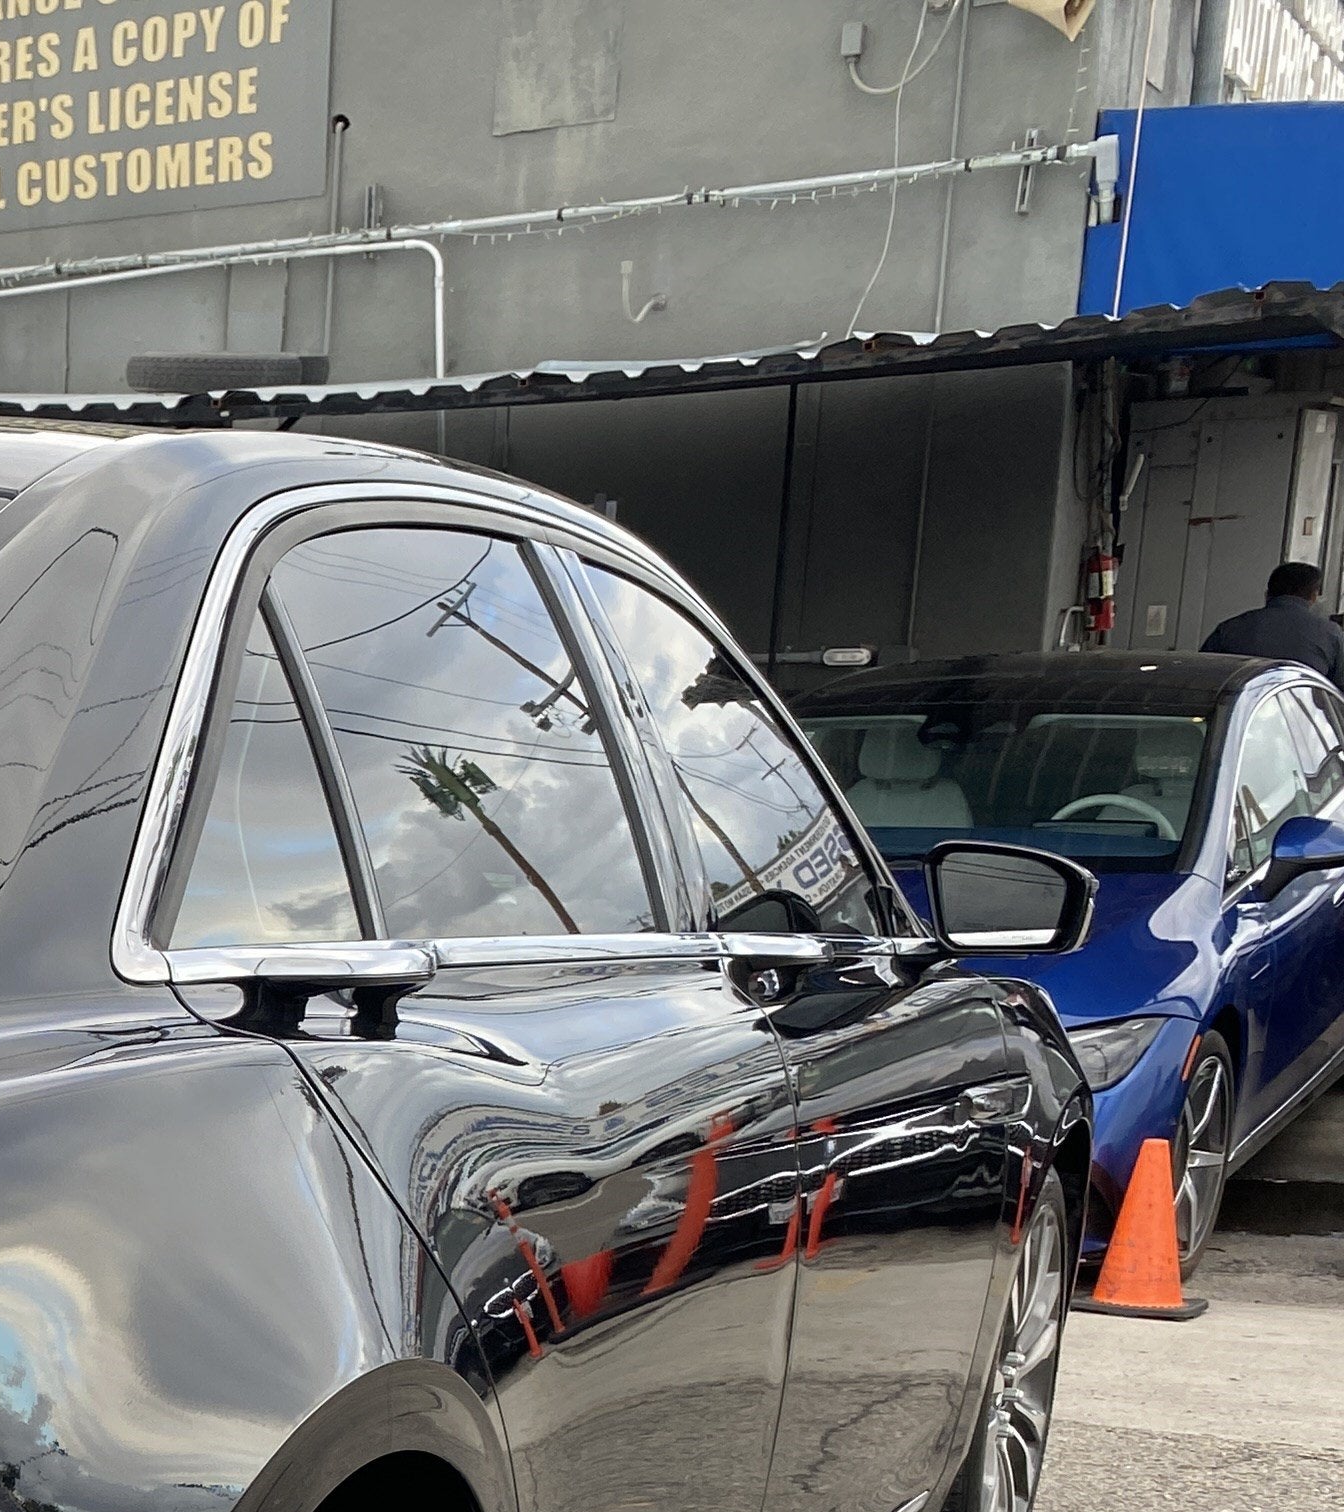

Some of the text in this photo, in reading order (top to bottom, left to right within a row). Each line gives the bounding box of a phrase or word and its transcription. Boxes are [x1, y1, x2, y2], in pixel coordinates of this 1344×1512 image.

[72, 27, 99, 73] A
[112, 8, 225, 68] COPY
[238, 0, 291, 49] OF
[87, 67, 259, 135] LICENSE
[16, 132, 274, 206] CUSTOMERS
